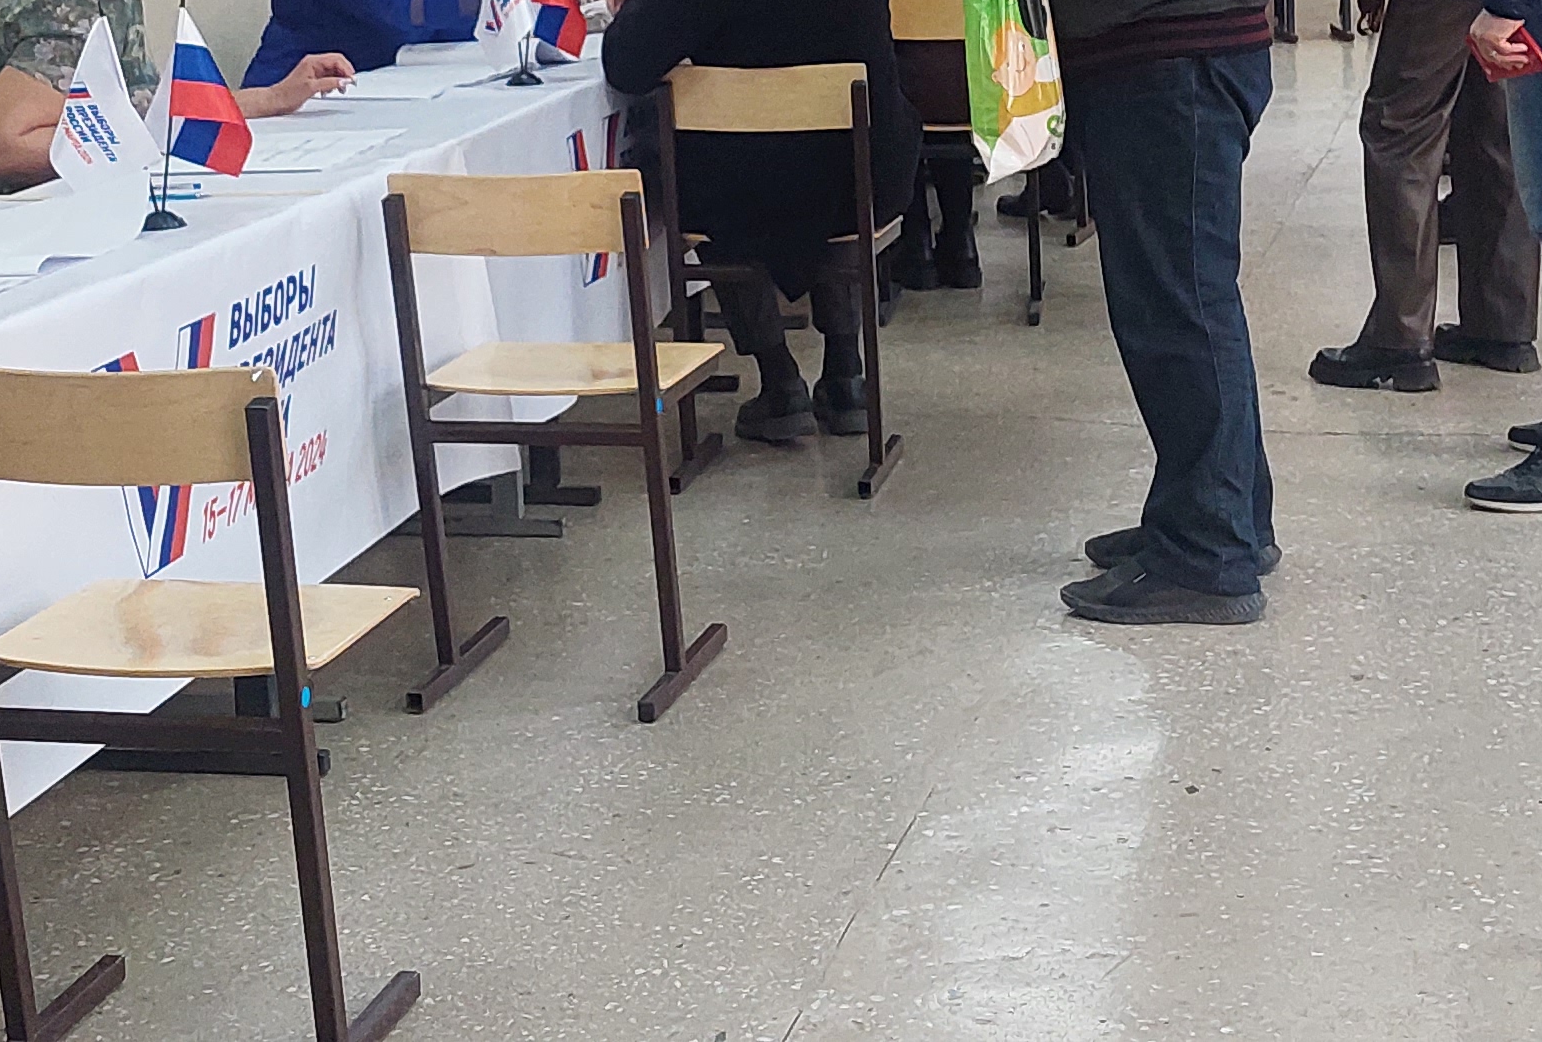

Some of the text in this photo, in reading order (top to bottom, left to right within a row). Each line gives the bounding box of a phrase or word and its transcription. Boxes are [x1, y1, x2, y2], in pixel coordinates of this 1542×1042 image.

[65, 105, 92, 143] РОССИИ
[74, 105, 117, 162] ПРЕЗИДЕНТА
[87, 104, 120, 145] ВЫБОРЫ
[228, 263, 316, 350] ВЫБОРЫ
[294, 429, 328, 484] 2024
